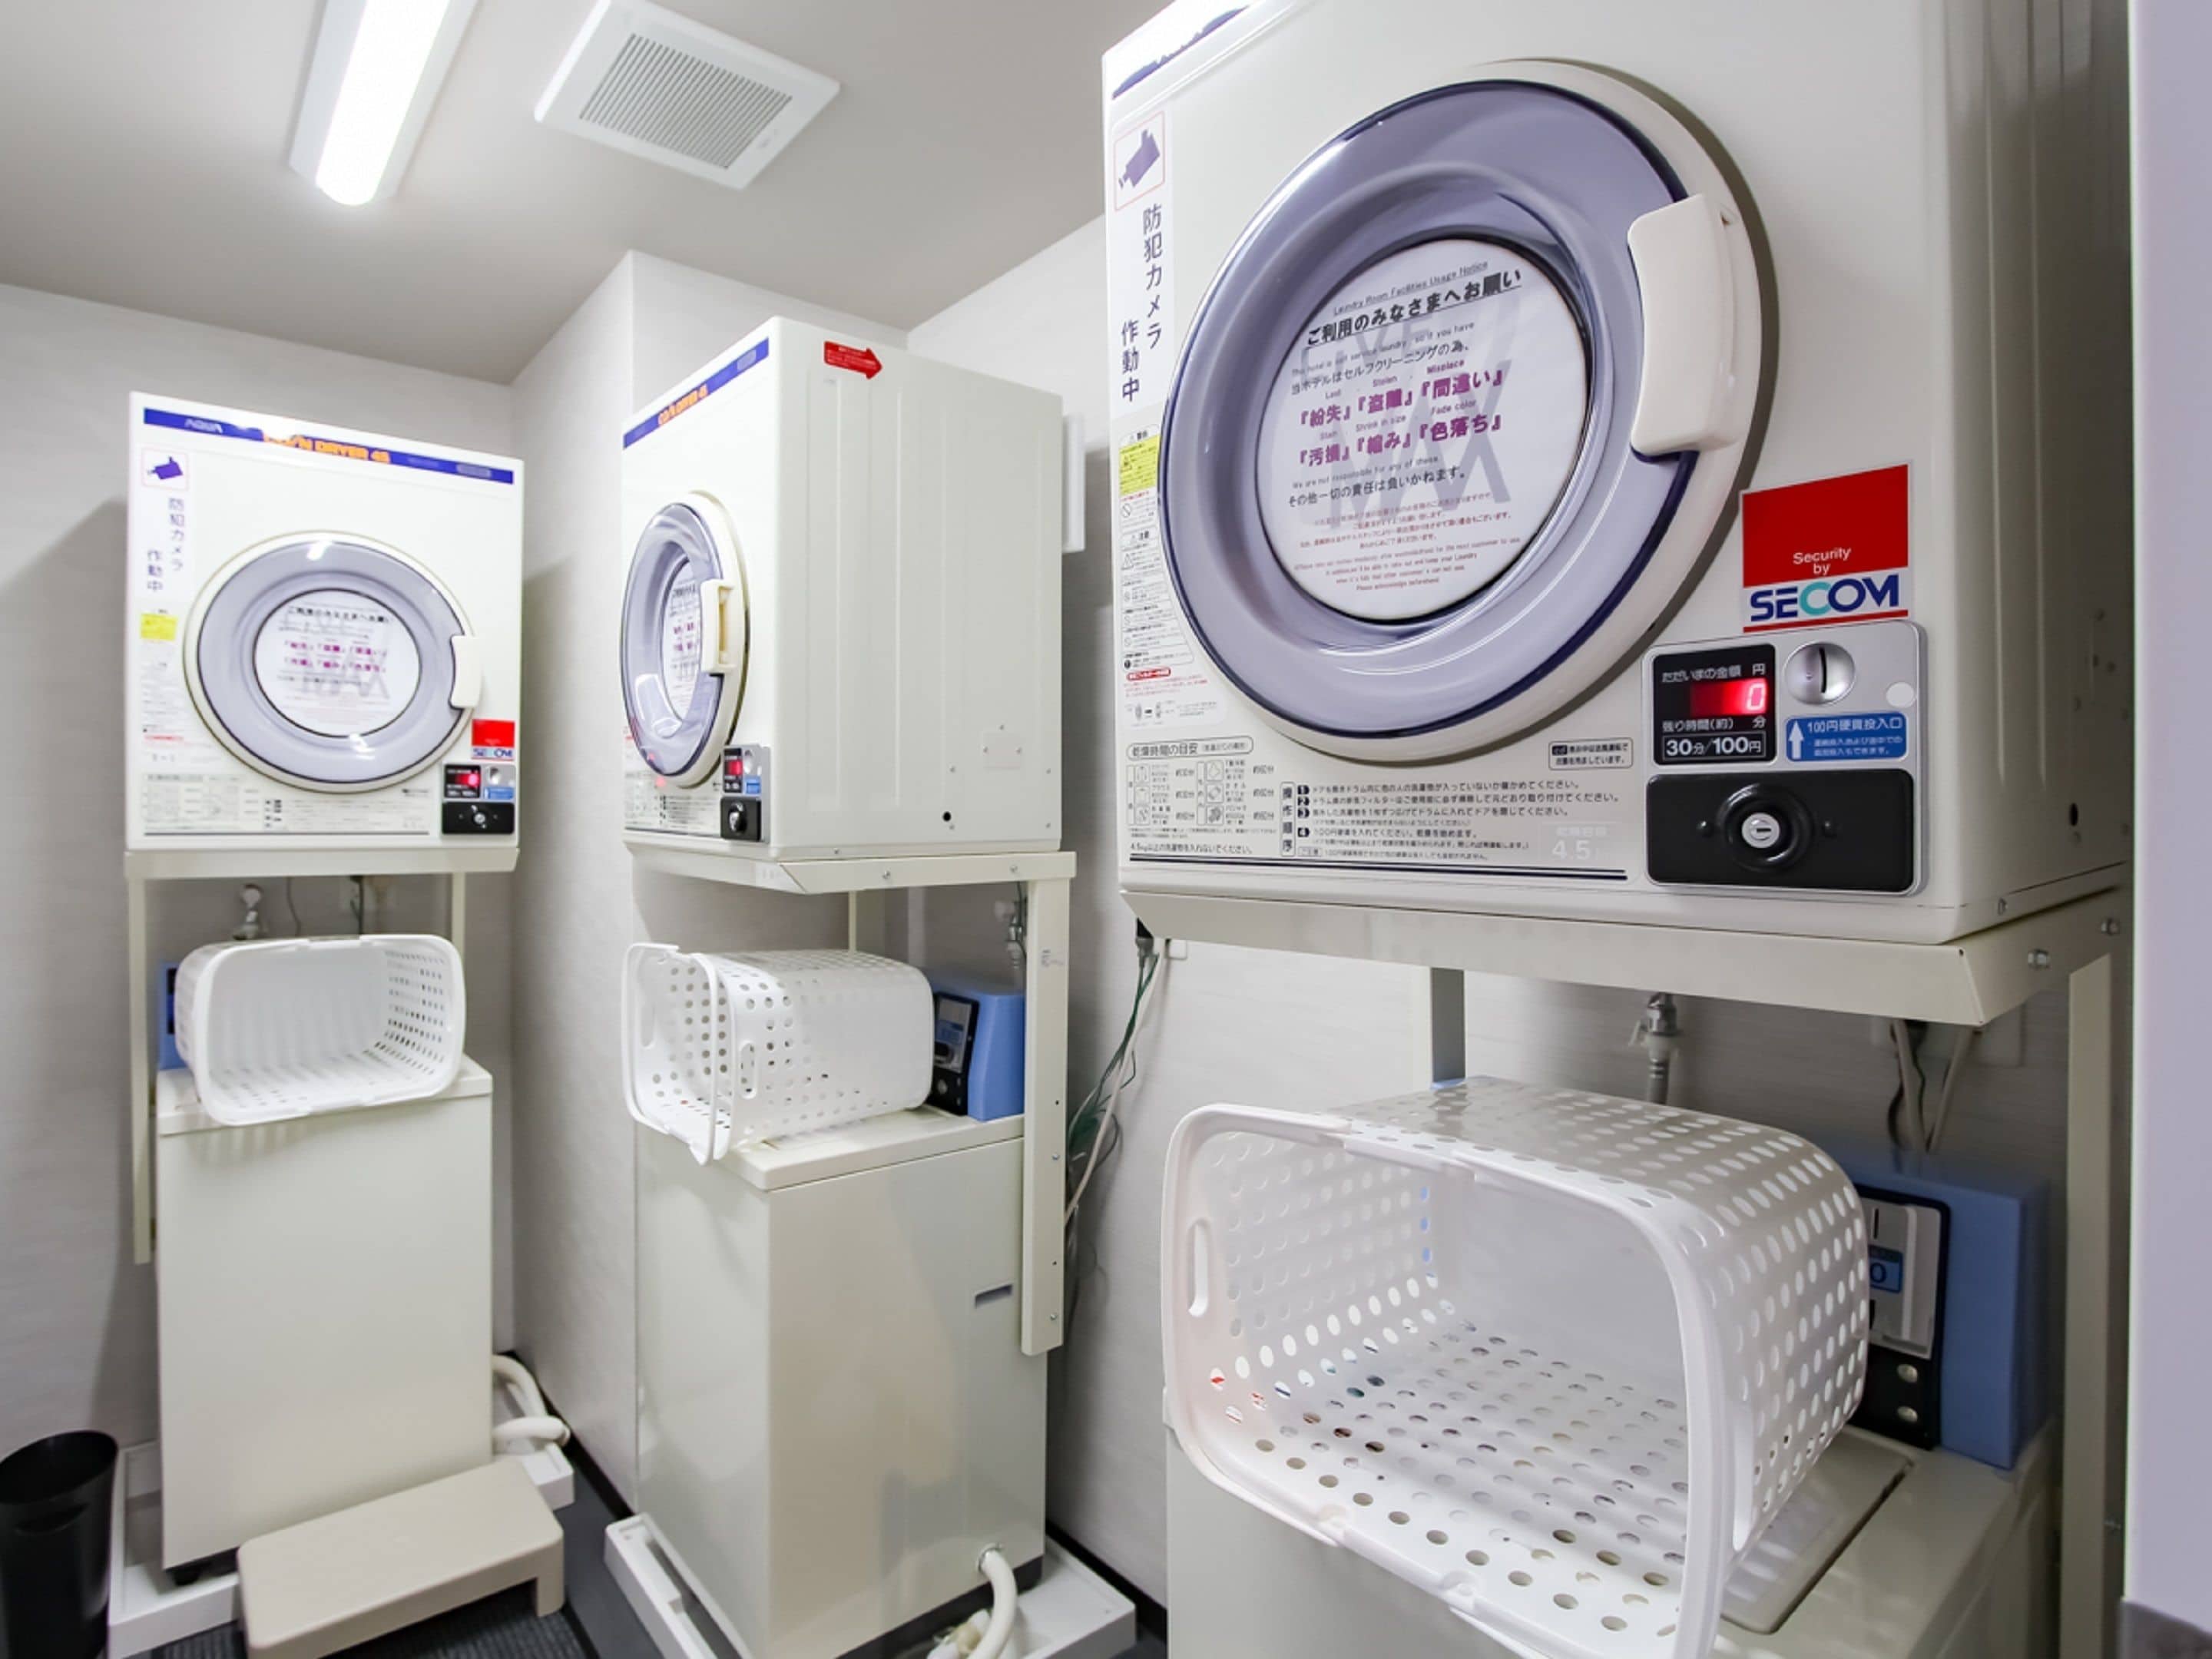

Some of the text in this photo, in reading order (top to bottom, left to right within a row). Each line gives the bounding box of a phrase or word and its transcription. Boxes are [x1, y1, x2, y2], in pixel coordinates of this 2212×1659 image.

[1143, 203, 1163, 349] 防犯カメラ
[1307, 269, 1522, 346] ご利用のみなさまへお願い
[1121, 319, 1140, 402] 作動中
[1793, 547, 1852, 565] Security
[1813, 563, 1830, 575] by
[1750, 574, 1899, 622] SECOM
[1752, 663, 1766, 675] 円
[1746, 681, 1767, 711] 0
[1662, 715, 1767, 733] 残り時間(約) 分
[1806, 717, 1902, 733] 100円硬貨投入口
[1666, 736, 1762, 757] 30分/100円
